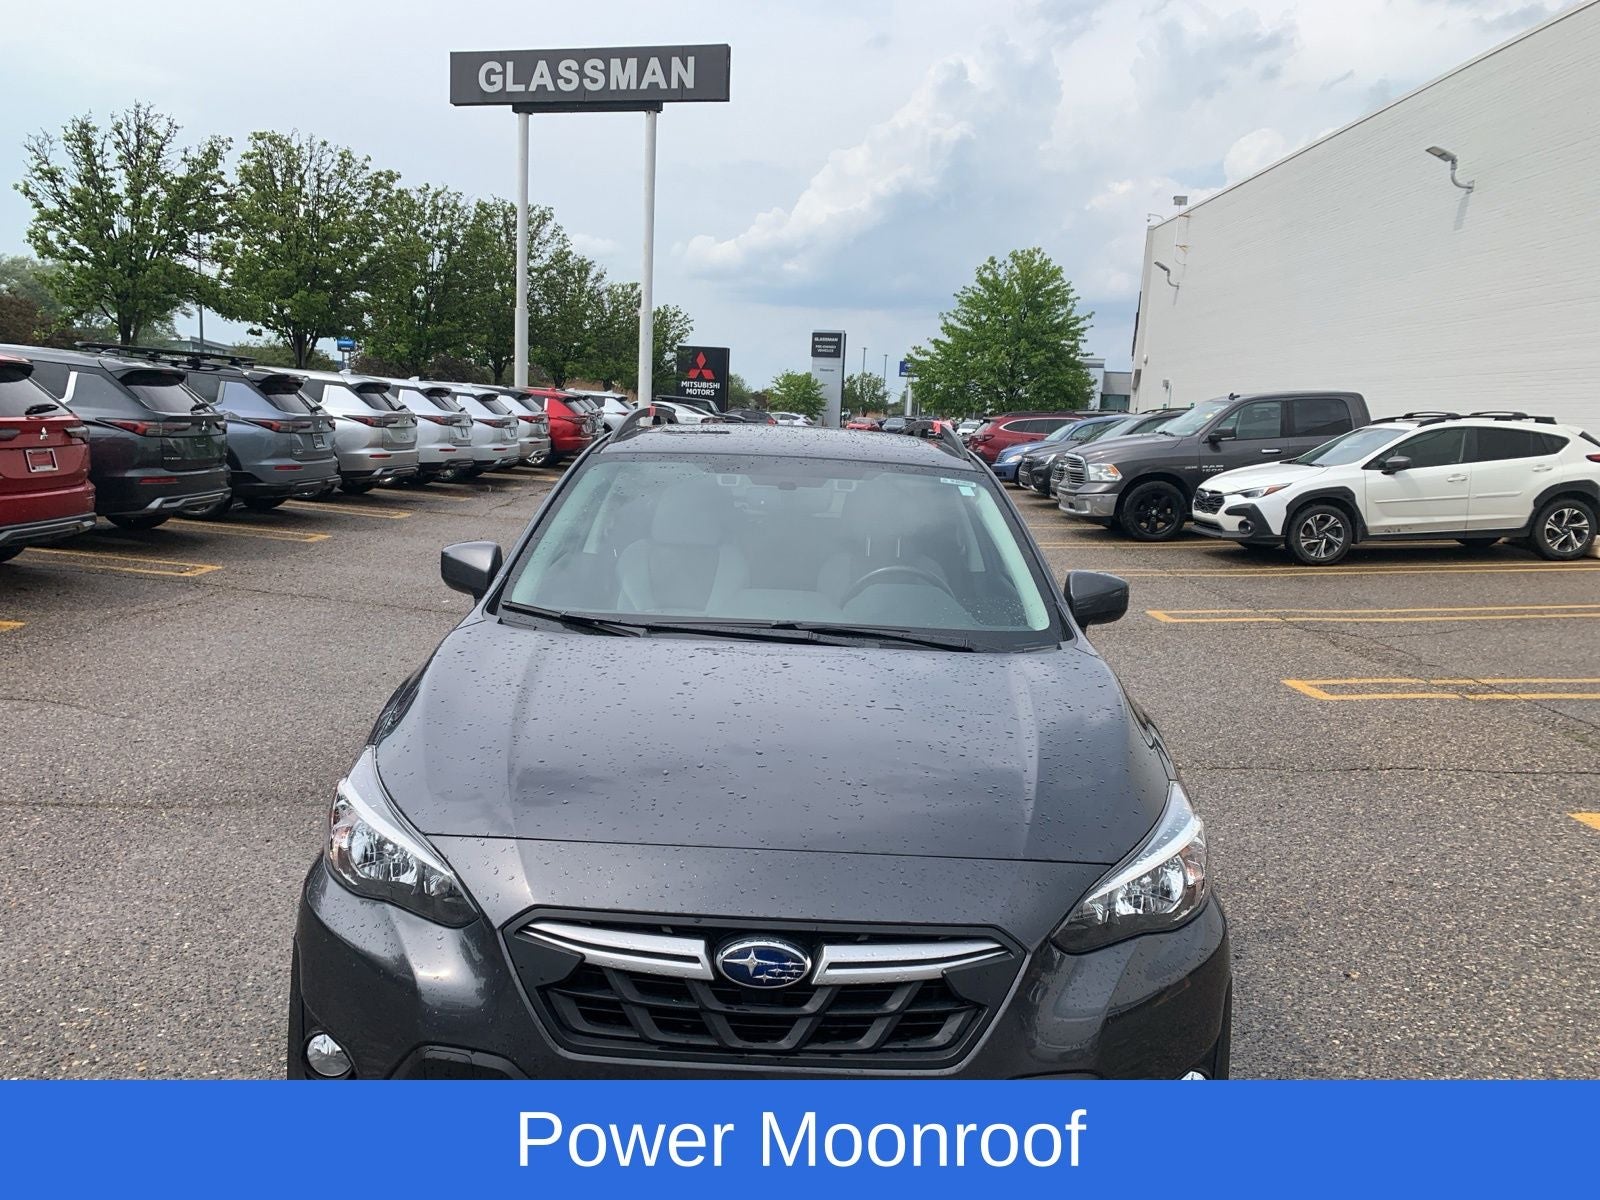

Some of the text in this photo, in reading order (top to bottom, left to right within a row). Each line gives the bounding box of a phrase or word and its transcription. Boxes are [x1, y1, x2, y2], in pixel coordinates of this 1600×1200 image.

[478, 56, 695, 93] GLASSMAN
[681, 381, 720, 389] MITSUBISHI
[685, 388, 715, 396] MOTORS
